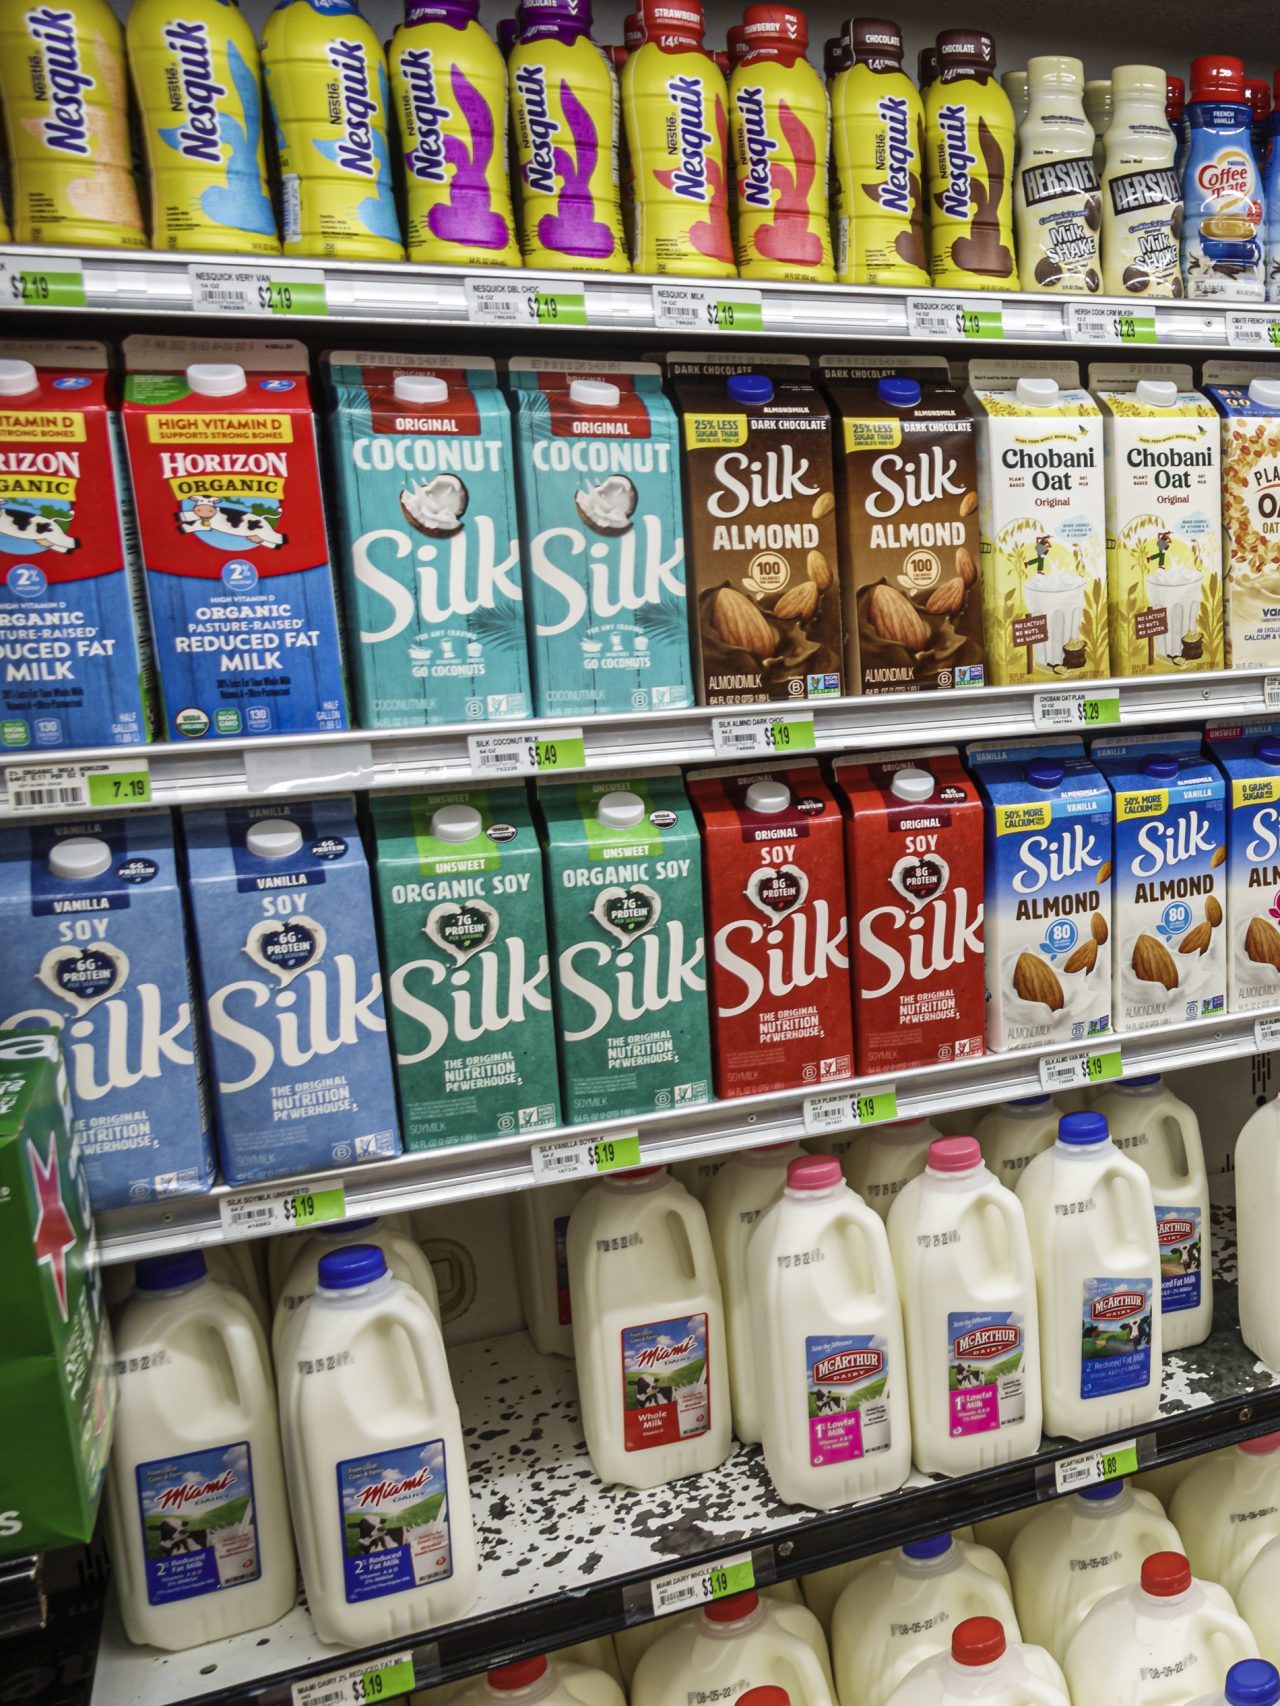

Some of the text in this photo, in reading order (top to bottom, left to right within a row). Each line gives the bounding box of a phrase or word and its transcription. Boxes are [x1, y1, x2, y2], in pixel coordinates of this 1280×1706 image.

[654, 9, 701, 21] STRAWBERRY
[866, 35, 900, 46] CHOCOLATE
[942, 44, 975, 54] CHOCOLATE
[28, 7, 96, 154] Nesquik
[33, 58, 46, 102] Nestlé
[165, 20, 225, 162] Nesquik
[168, 69, 182, 112] Nestlé
[331, 39, 378, 176] Nesquik
[402, 49, 450, 182] Nesquik
[517, 64, 562, 194] Nesquik
[667, 116, 679, 155] Nestlé
[667, 75, 714, 201] Nesquik
[740, 86, 778, 206] Nesquik
[878, 97, 915, 214] Nesquik
[938, 104, 973, 219] Nesquik
[1198, 161, 1248, 191] Coffee
[1211, 179, 1248, 202] mate
[1047, 224, 1086, 247] Milk
[1045, 239, 1097, 262] SHAKE
[196, 273, 271, 283] NESQUICK VERY VAN
[258, 286, 293, 311] $2.19
[658, 291, 705, 300] NESQUICK MILK
[528, 297, 558, 319] $2.19
[708, 304, 734, 326] $2.19
[1113, 318, 1136, 338] $2.29
[159, 419, 282, 429] HIGH VITAMIN D
[396, 418, 458, 432] ORIGINAL
[572, 421, 630, 435] ORIGINAL
[694, 420, 738, 430] 25% LESS
[696, 430, 739, 438] SUGAR THAN
[751, 420, 826, 431] DARK CHOCOLATE
[161, 452, 288, 479] HORIZON
[352, 439, 502, 471] COCONUT
[532, 441, 671, 472] COCONUT
[1002, 447, 1095, 469] Chobani
[178, 478, 278, 495] ORGANIC
[707, 444, 820, 518] Silk
[864, 446, 965, 518] Silk
[1032, 471, 1071, 491] Oat
[1035, 497, 1071, 508] Original
[713, 524, 819, 550] ALMOND
[870, 522, 966, 549] ALMOND
[352, 516, 523, 643] Silk
[530, 515, 686, 636] Silk
[757, 562, 780, 576] 100
[196, 604, 291, 619] ORGANIC
[189, 620, 301, 632] PASTURE-RAISED
[176, 631, 320, 651] REDUCED FAT
[221, 652, 283, 671] MILK
[412, 664, 485, 677] GO COCONUTS
[1078, 704, 1100, 720] $5.29
[492, 737, 523, 746] COCONUT
[764, 727, 790, 746] $5.19
[528, 745, 558, 766] $5.49
[113, 780, 145, 798] 7.19
[1183, 788, 1212, 799] VANILLA
[755, 827, 798, 840] ORIGINAL
[1131, 811, 1215, 878] Silk
[761, 845, 796, 864] SOY
[1012, 826, 1102, 893] Silk
[435, 860, 485, 873] UNSWEET
[562, 859, 690, 887] ORGANIC SOY
[256, 874, 307, 889] VANILLA
[392, 874, 530, 903] ORGANIC SOY
[763, 885, 796, 897] PROTEIN
[1135, 874, 1214, 904] ALMOND
[262, 894, 307, 916] SOY
[1016, 890, 1100, 921] ALMOND
[445, 923, 484, 935] PROTEIN
[1053, 926, 1070, 939] 80
[267, 941, 311, 955] PROTEIN
[859, 888, 984, 999] Silk
[714, 900, 849, 1018] Silk
[559, 921, 705, 1041] Silk
[390, 937, 552, 1064] Silk
[209, 954, 387, 1093] Silk
[271, 1077, 347, 1096] THE ORIGINAL
[272, 1087, 349, 1110] NUTRITION
[851, 1098, 874, 1118] $5.19
[588, 1144, 615, 1164] $5.19
[284, 1195, 314, 1220] $5.19
[1094, 1295, 1142, 1315] McARTHUR
[635, 1336, 696, 1368] Miami
[818, 1355, 879, 1376] McARTHUR
[833, 1370, 864, 1381] DAIRY
[638, 1410, 667, 1422] Whole
[643, 1418, 662, 1428] Milk
[1097, 1458, 1117, 1476] $3.89
[354, 1466, 433, 1508] Miami
[353, 1676, 383, 1698] $3.19
